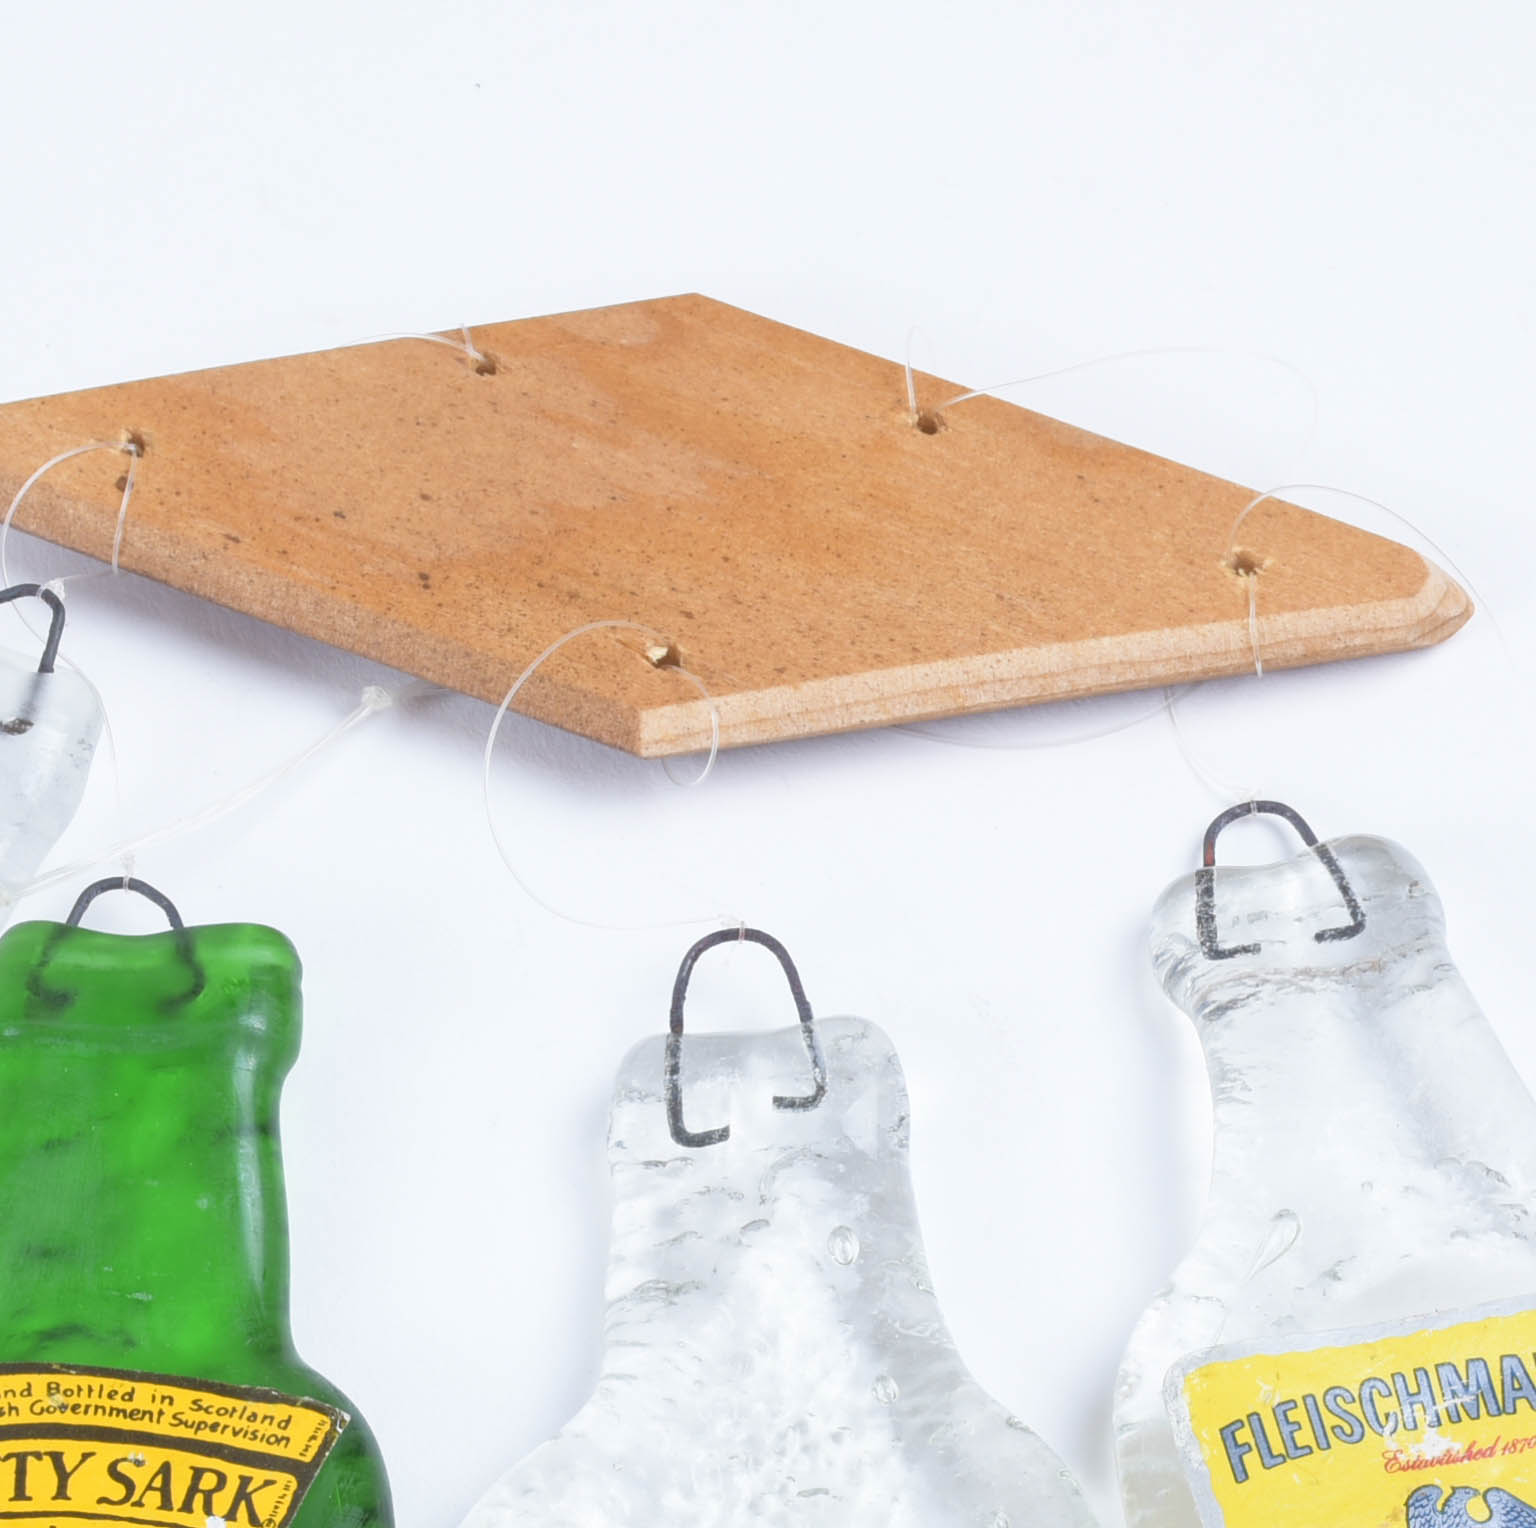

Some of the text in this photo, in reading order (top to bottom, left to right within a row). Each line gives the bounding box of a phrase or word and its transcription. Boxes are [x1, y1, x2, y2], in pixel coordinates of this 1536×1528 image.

[32, 1398, 166, 1425] Government
[168, 1411, 291, 1449] Supervision
[46, 1381, 136, 1403] Bottled
[151, 1393, 175, 1407] in
[188, 1398, 293, 1432] Scotland
